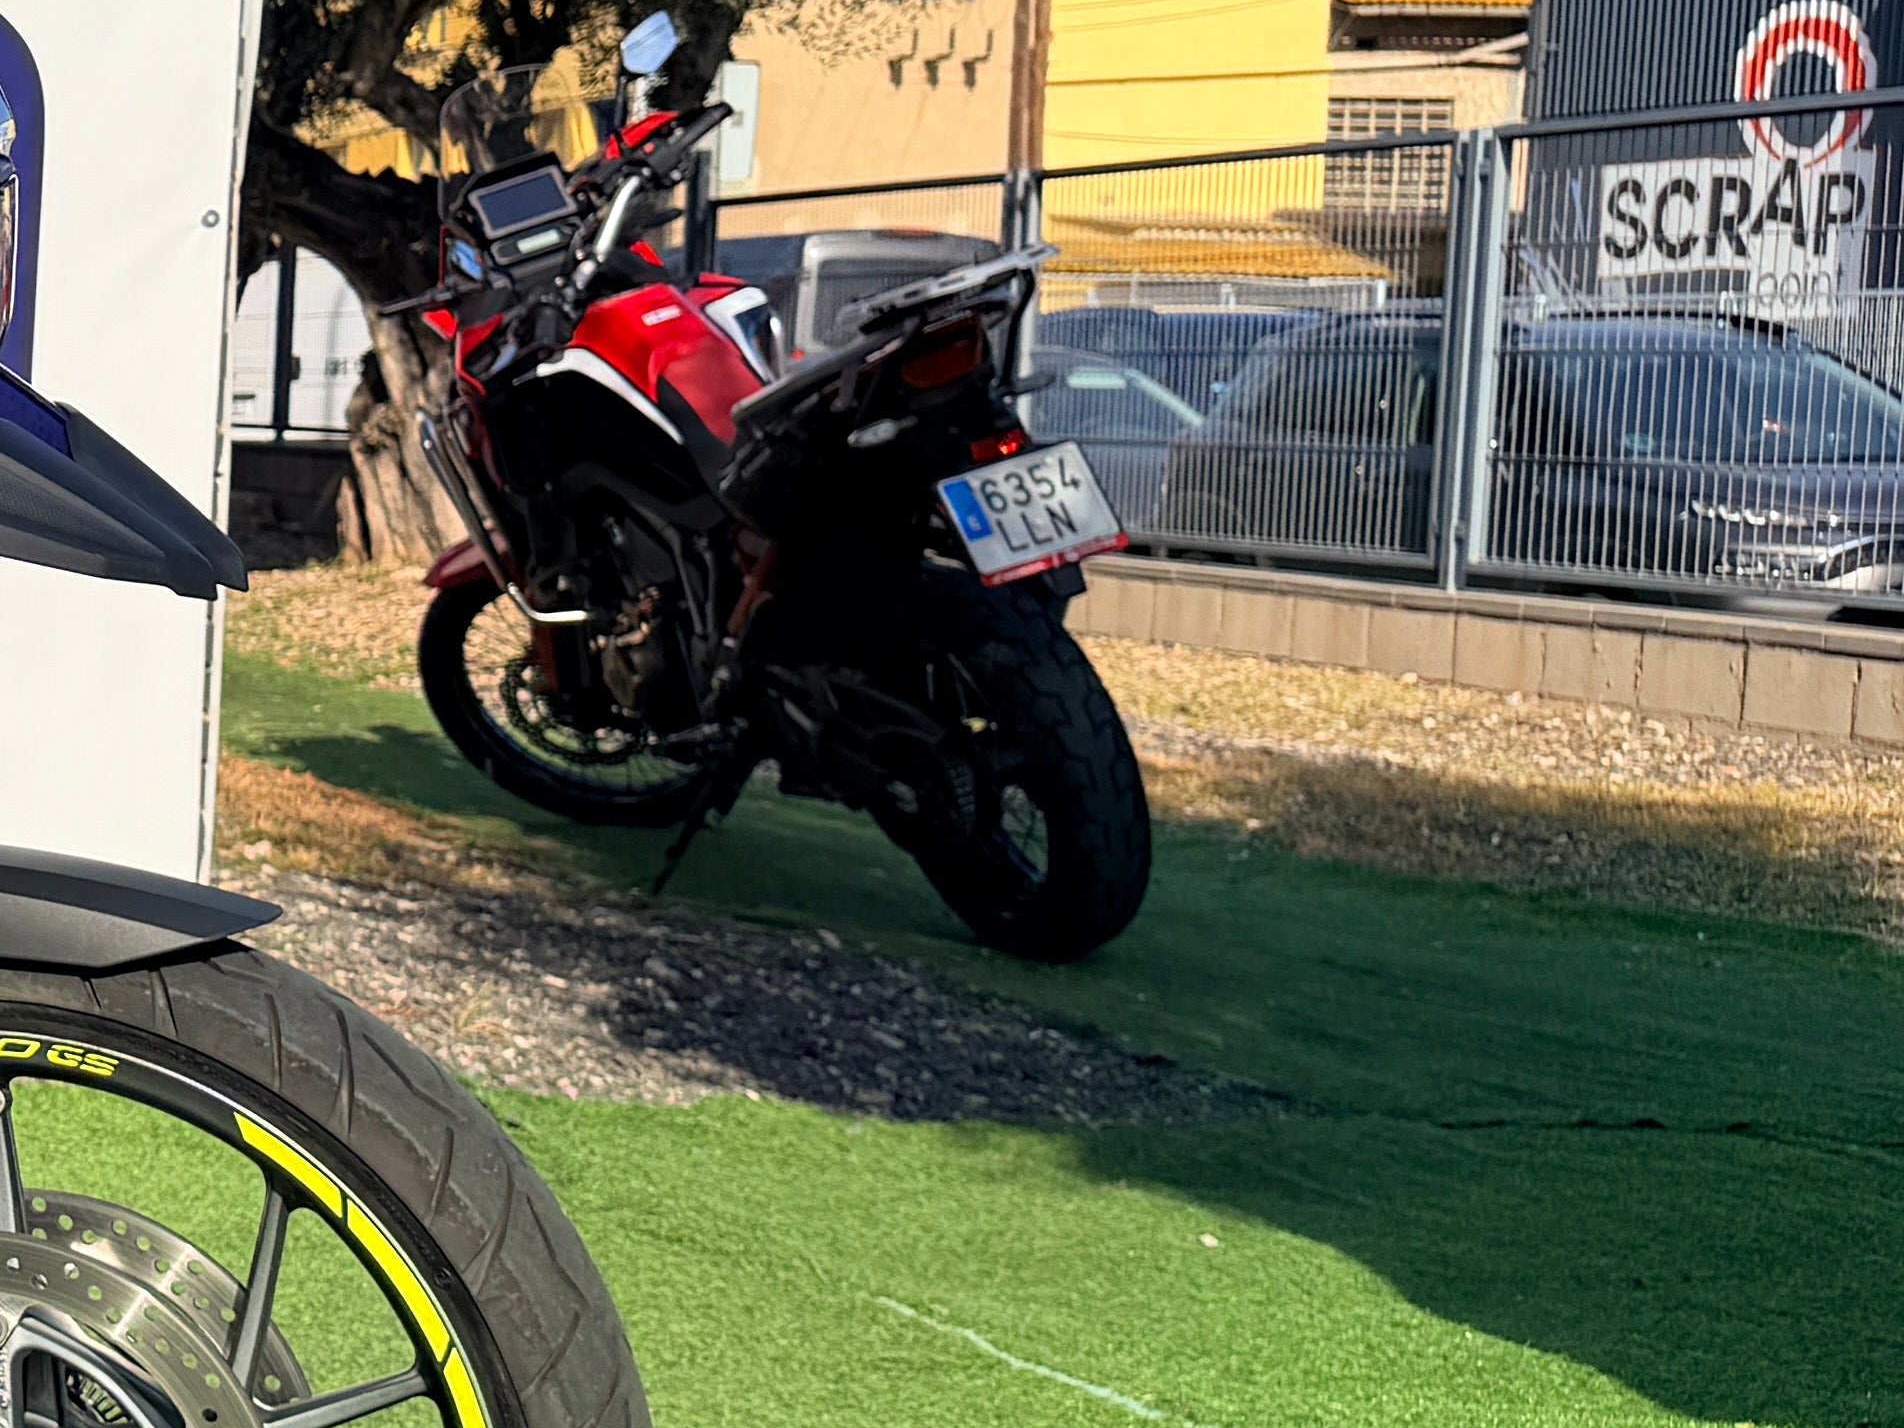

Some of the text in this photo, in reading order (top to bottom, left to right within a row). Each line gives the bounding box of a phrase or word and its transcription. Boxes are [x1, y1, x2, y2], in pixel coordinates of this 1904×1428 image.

[1604, 158, 1866, 260] SCRAP
[980, 457, 1081, 514] 6354
[996, 503, 1078, 553] LLN
[46, 1044, 120, 1076] GS
